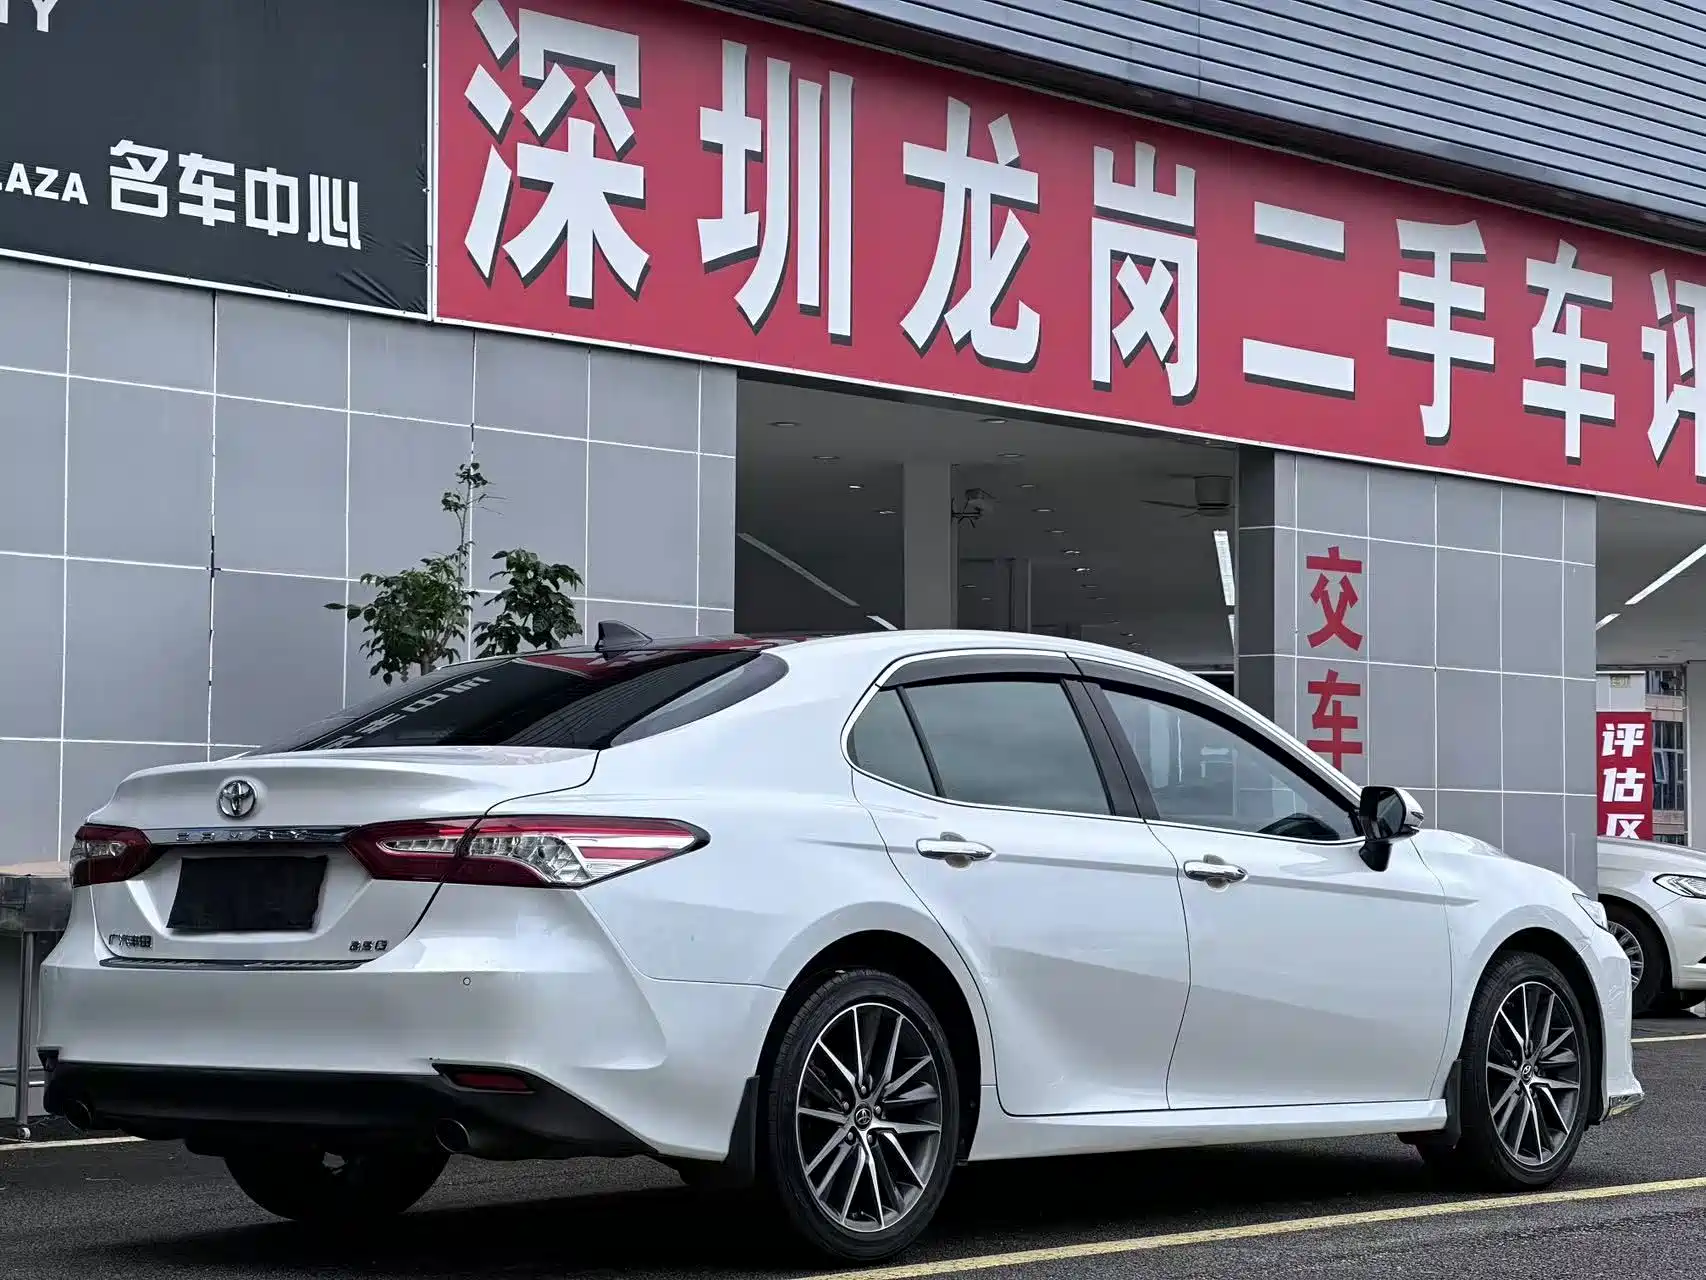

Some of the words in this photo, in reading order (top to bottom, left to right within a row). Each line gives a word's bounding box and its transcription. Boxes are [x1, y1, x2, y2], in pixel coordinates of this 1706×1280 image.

[0, 163, 88, 205] AZA
[110, 140, 361, 250] 名车中心
[1306, 546, 1363, 770] 交车
[1602, 723, 1645, 839] 评估区
